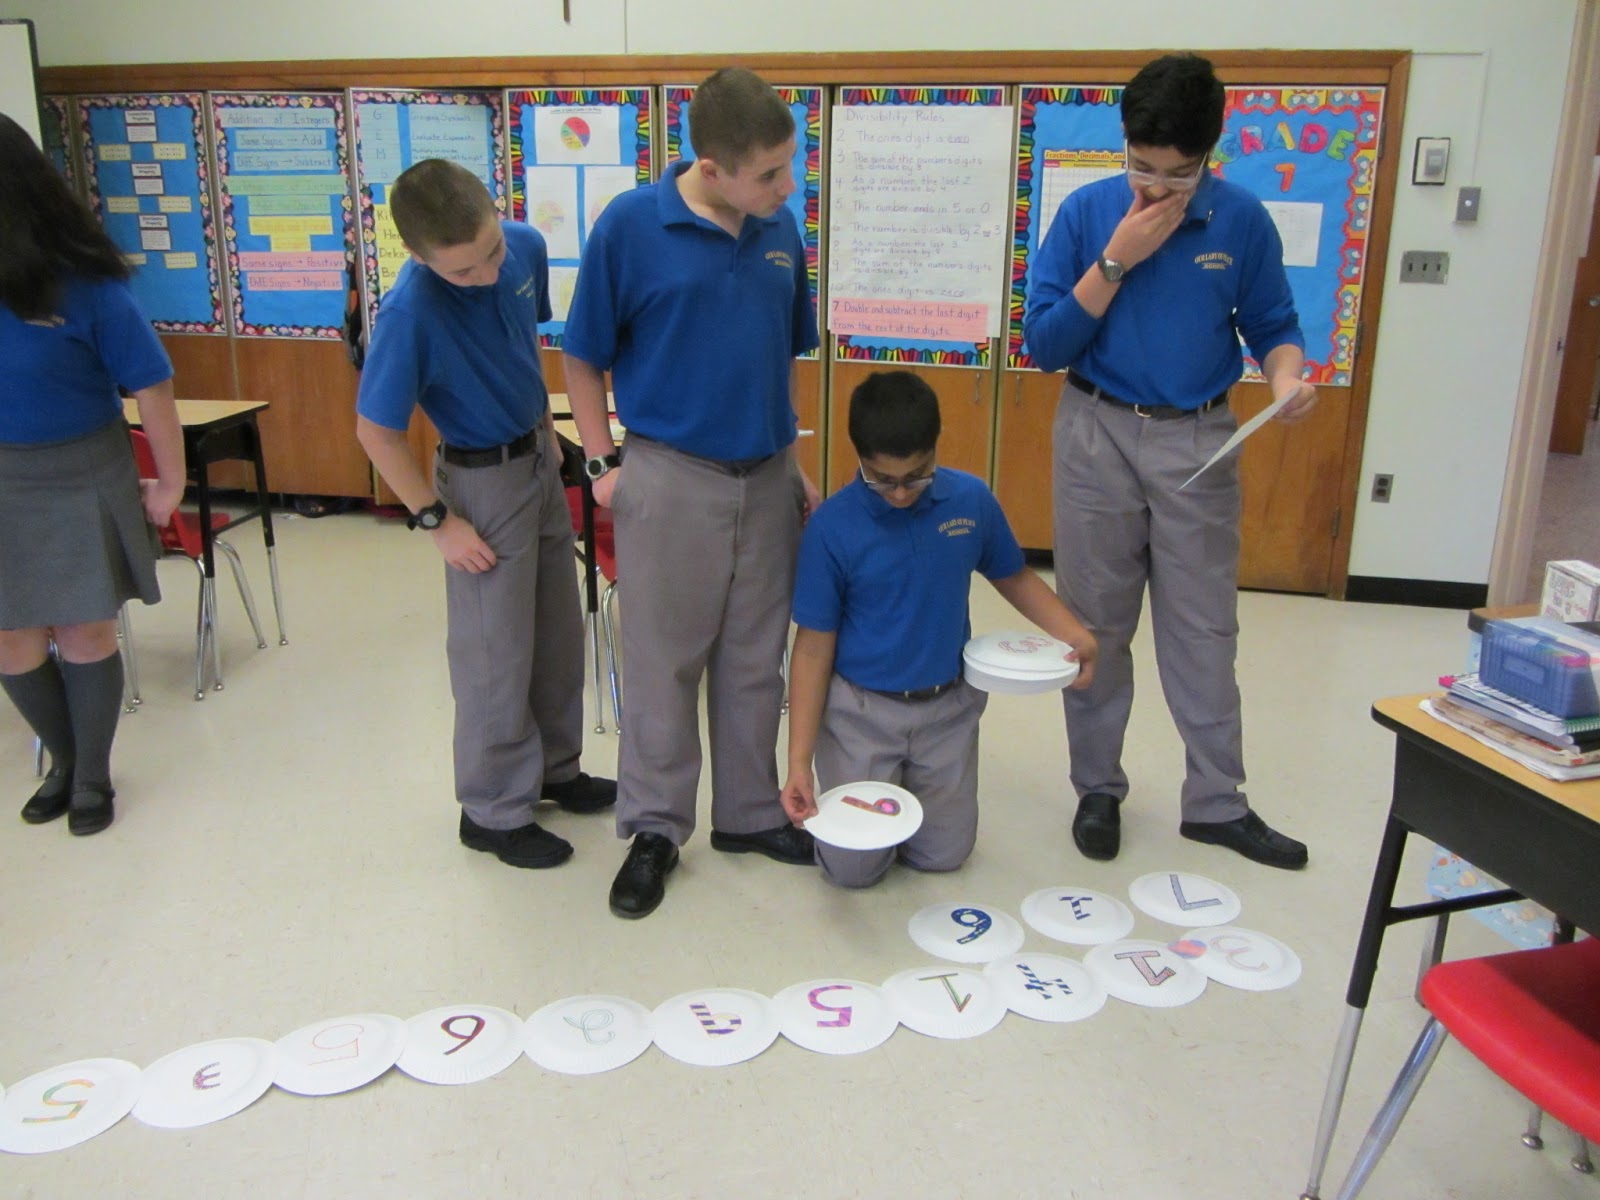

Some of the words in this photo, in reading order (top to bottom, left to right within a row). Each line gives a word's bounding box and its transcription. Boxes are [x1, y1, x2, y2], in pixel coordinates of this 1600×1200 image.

[228, 112, 264, 124] Addition
[274, 112, 283, 124] of
[294, 112, 330, 128] Integers
[373, 109, 382, 120] G
[846, 108, 908, 128] Divisibility
[916, 109, 945, 122] Rules
[302, 134, 323, 145] Add
[836, 129, 845, 142] 2
[856, 130, 875, 142] The
[878, 133, 902, 144] ones
[906, 131, 930, 149] digit
[936, 133, 944, 143] is
[1213, 122, 1355, 163] GRADE
[294, 156, 332, 167] Subtract
[836, 150, 846, 164] 3
[854, 152, 868, 164] The
[888, 152, 897, 164] of
[898, 153, 914, 164] the
[954, 155, 983, 168] digits
[902, 164, 913, 176] by
[1275, 162, 1296, 193] 7
[834, 178, 842, 189] 4
[852, 176, 865, 185] As
[922, 176, 937, 186] the
[942, 176, 959, 186] last
[926, 185, 937, 195] by
[854, 200, 871, 213] The
[876, 202, 909, 213] number
[914, 202, 935, 213] ends
[938, 204, 947, 214] in
[952, 202, 962, 214] 5
[966, 206, 975, 214] or
[980, 202, 990, 214] 0
[852, 222, 870, 233] The
[872, 224, 907, 234] number
[922, 224, 953, 235] divisible
[959, 224, 970, 241] by
[973, 224, 982, 235] 2
[994, 224, 1001, 236] 3
[952, 240, 958, 249] 3
[307, 256, 344, 268] Positive
[832, 258, 840, 272] 9
[854, 258, 867, 267] The
[894, 258, 903, 268] of
[908, 260, 923, 269] the
[968, 261, 992, 273] digits
[303, 276, 341, 289] Negative
[854, 282, 868, 292] The
[872, 286, 892, 294] ones
[898, 286, 920, 299] digit
[833, 300, 840, 312] 7
[844, 301, 869, 314] Double
[871, 304, 884, 314] and
[885, 304, 917, 316] subtract
[920, 304, 934, 316] the
[937, 304, 954, 317] last
[958, 306, 981, 321] digit
[858, 320, 872, 331] the
[876, 322, 893, 332] rest
[896, 322, 906, 333] of
[908, 322, 921, 333] the
[922, 324, 950, 337] digits
[1060, 896, 1093, 920] 1
[1209, 934, 1270, 973] 3
[1114, 950, 1177, 987] 1
[1016, 962, 1074, 1001] 4
[807, 984, 854, 1029] 5
[307, 1023, 366, 1067] 5
[192, 1061, 222, 1091] 3
[20, 1078, 95, 1125] 5
